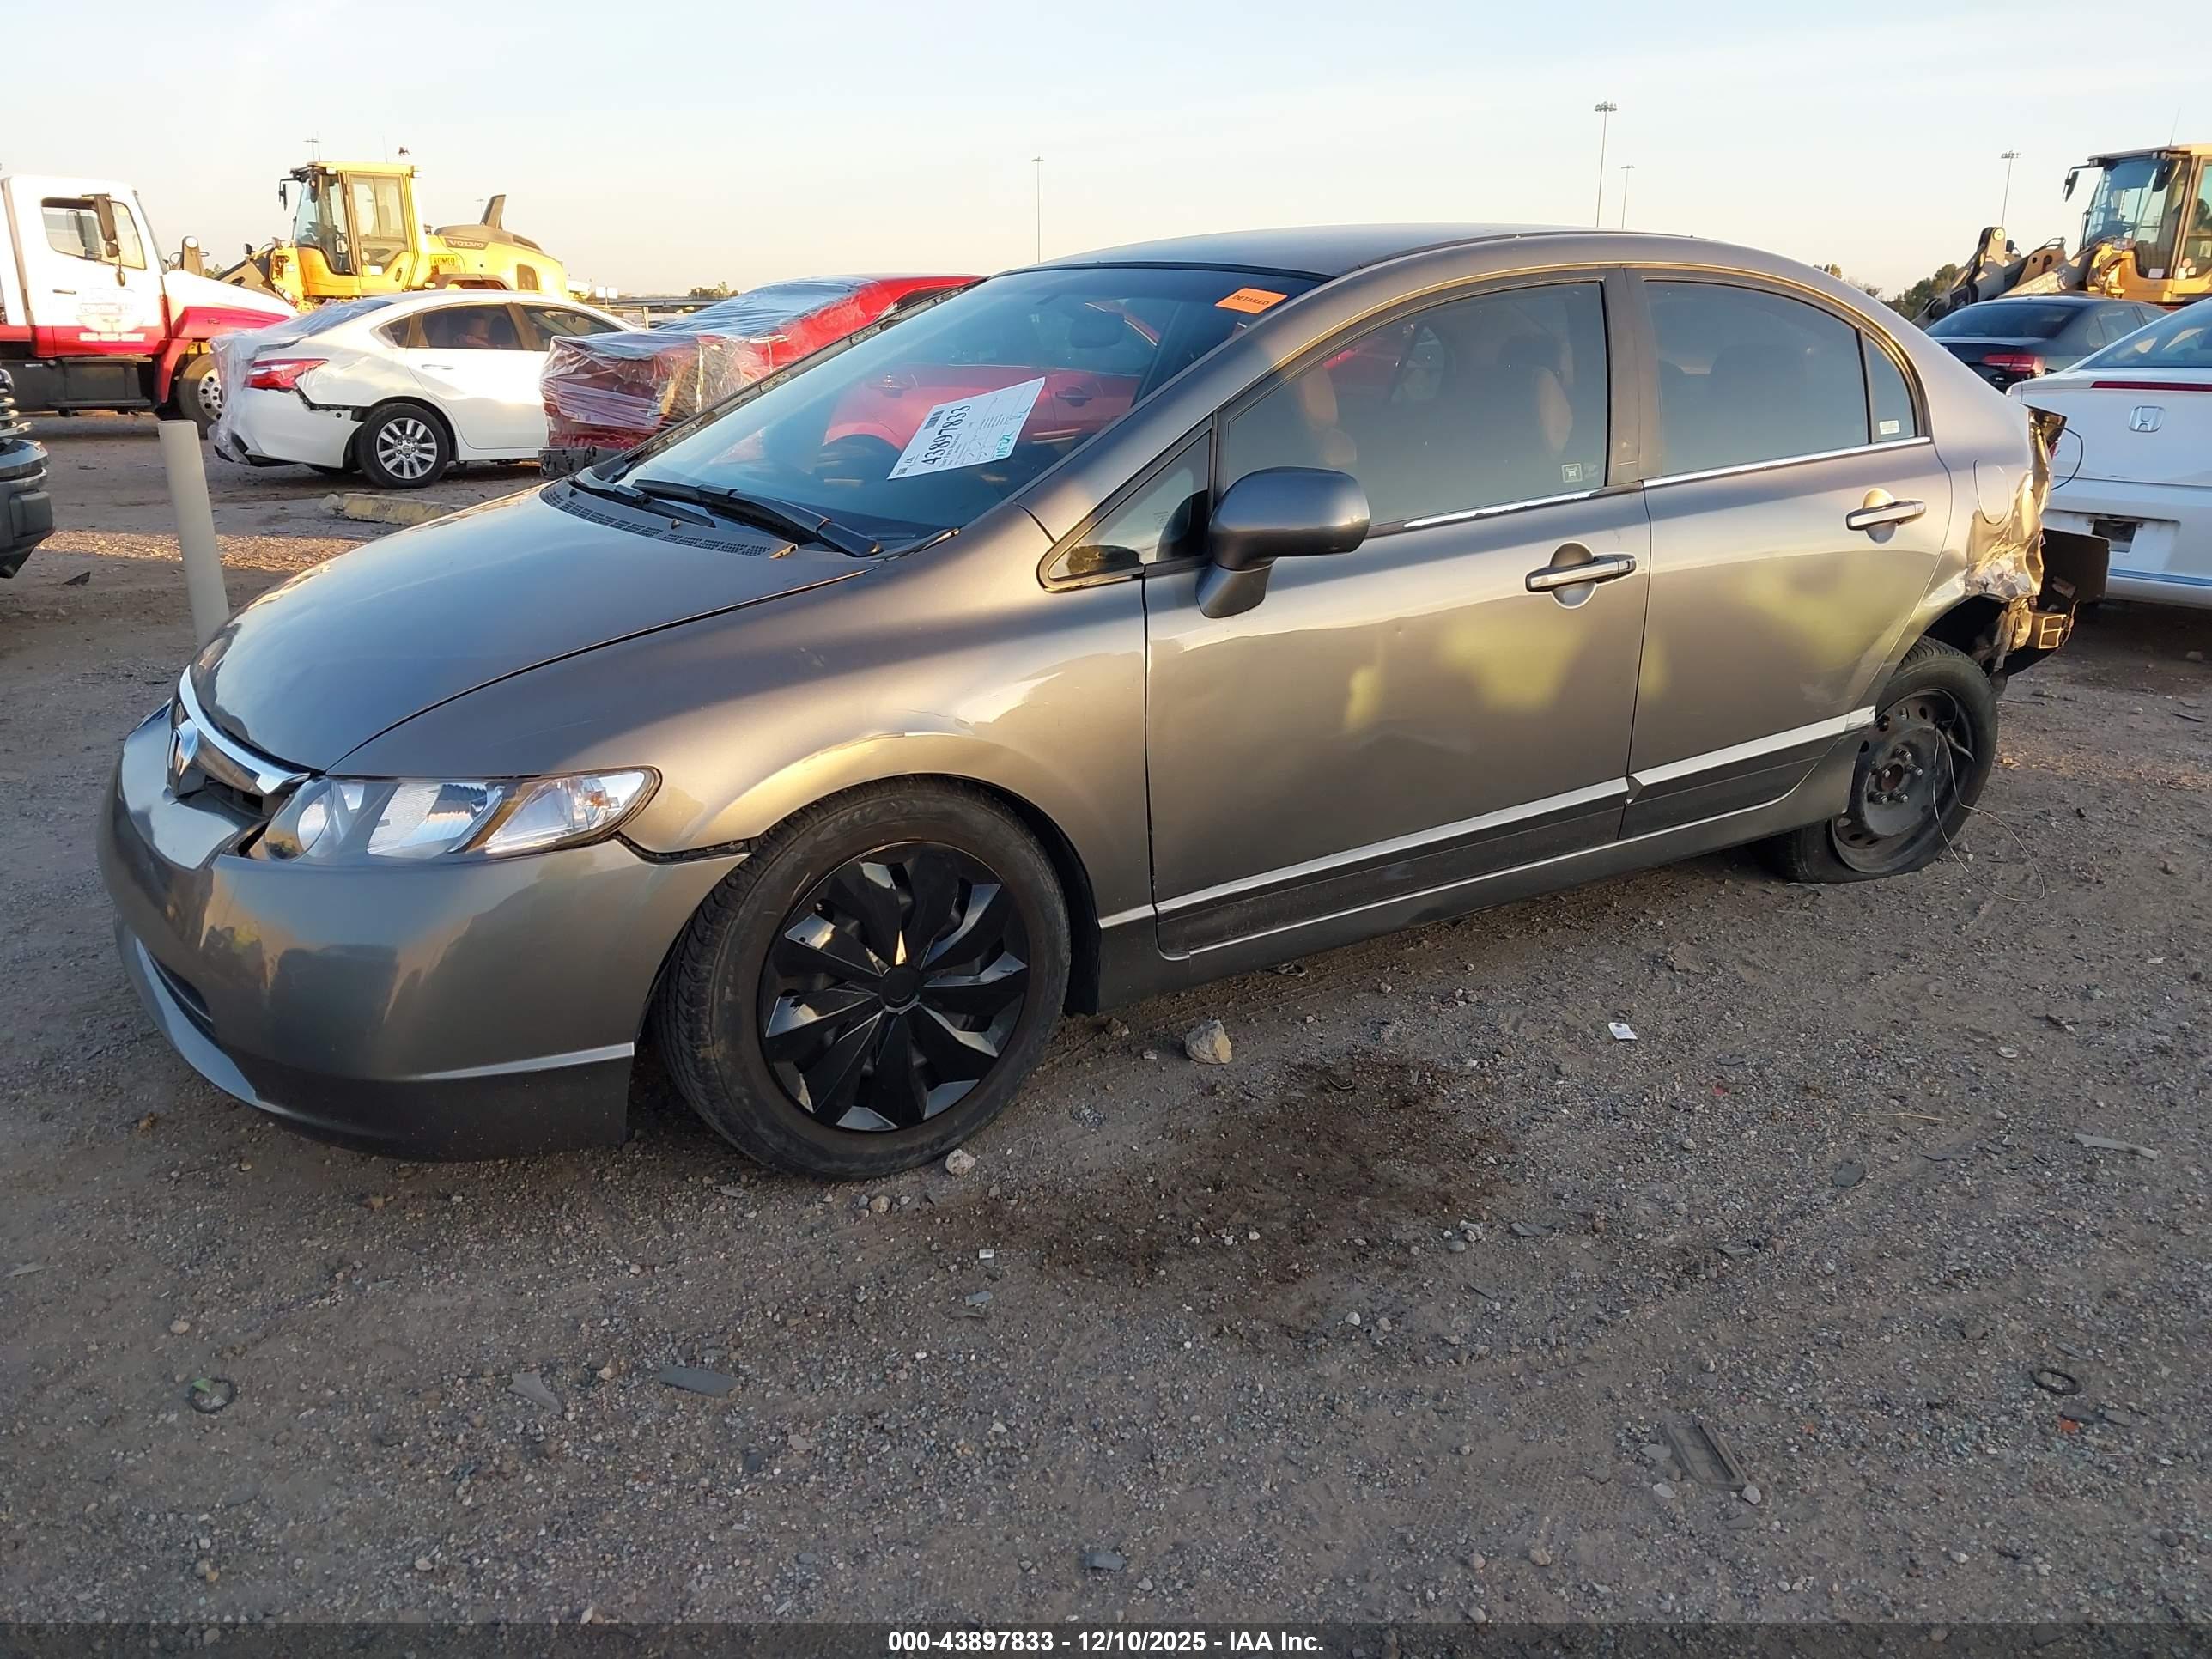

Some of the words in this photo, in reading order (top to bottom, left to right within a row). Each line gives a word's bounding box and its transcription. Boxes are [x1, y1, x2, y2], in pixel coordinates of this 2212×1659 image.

[447, 240, 485, 248] VOLVO
[1231, 295, 1271, 306] DETAILED
[921, 404, 971, 465] 43897833
